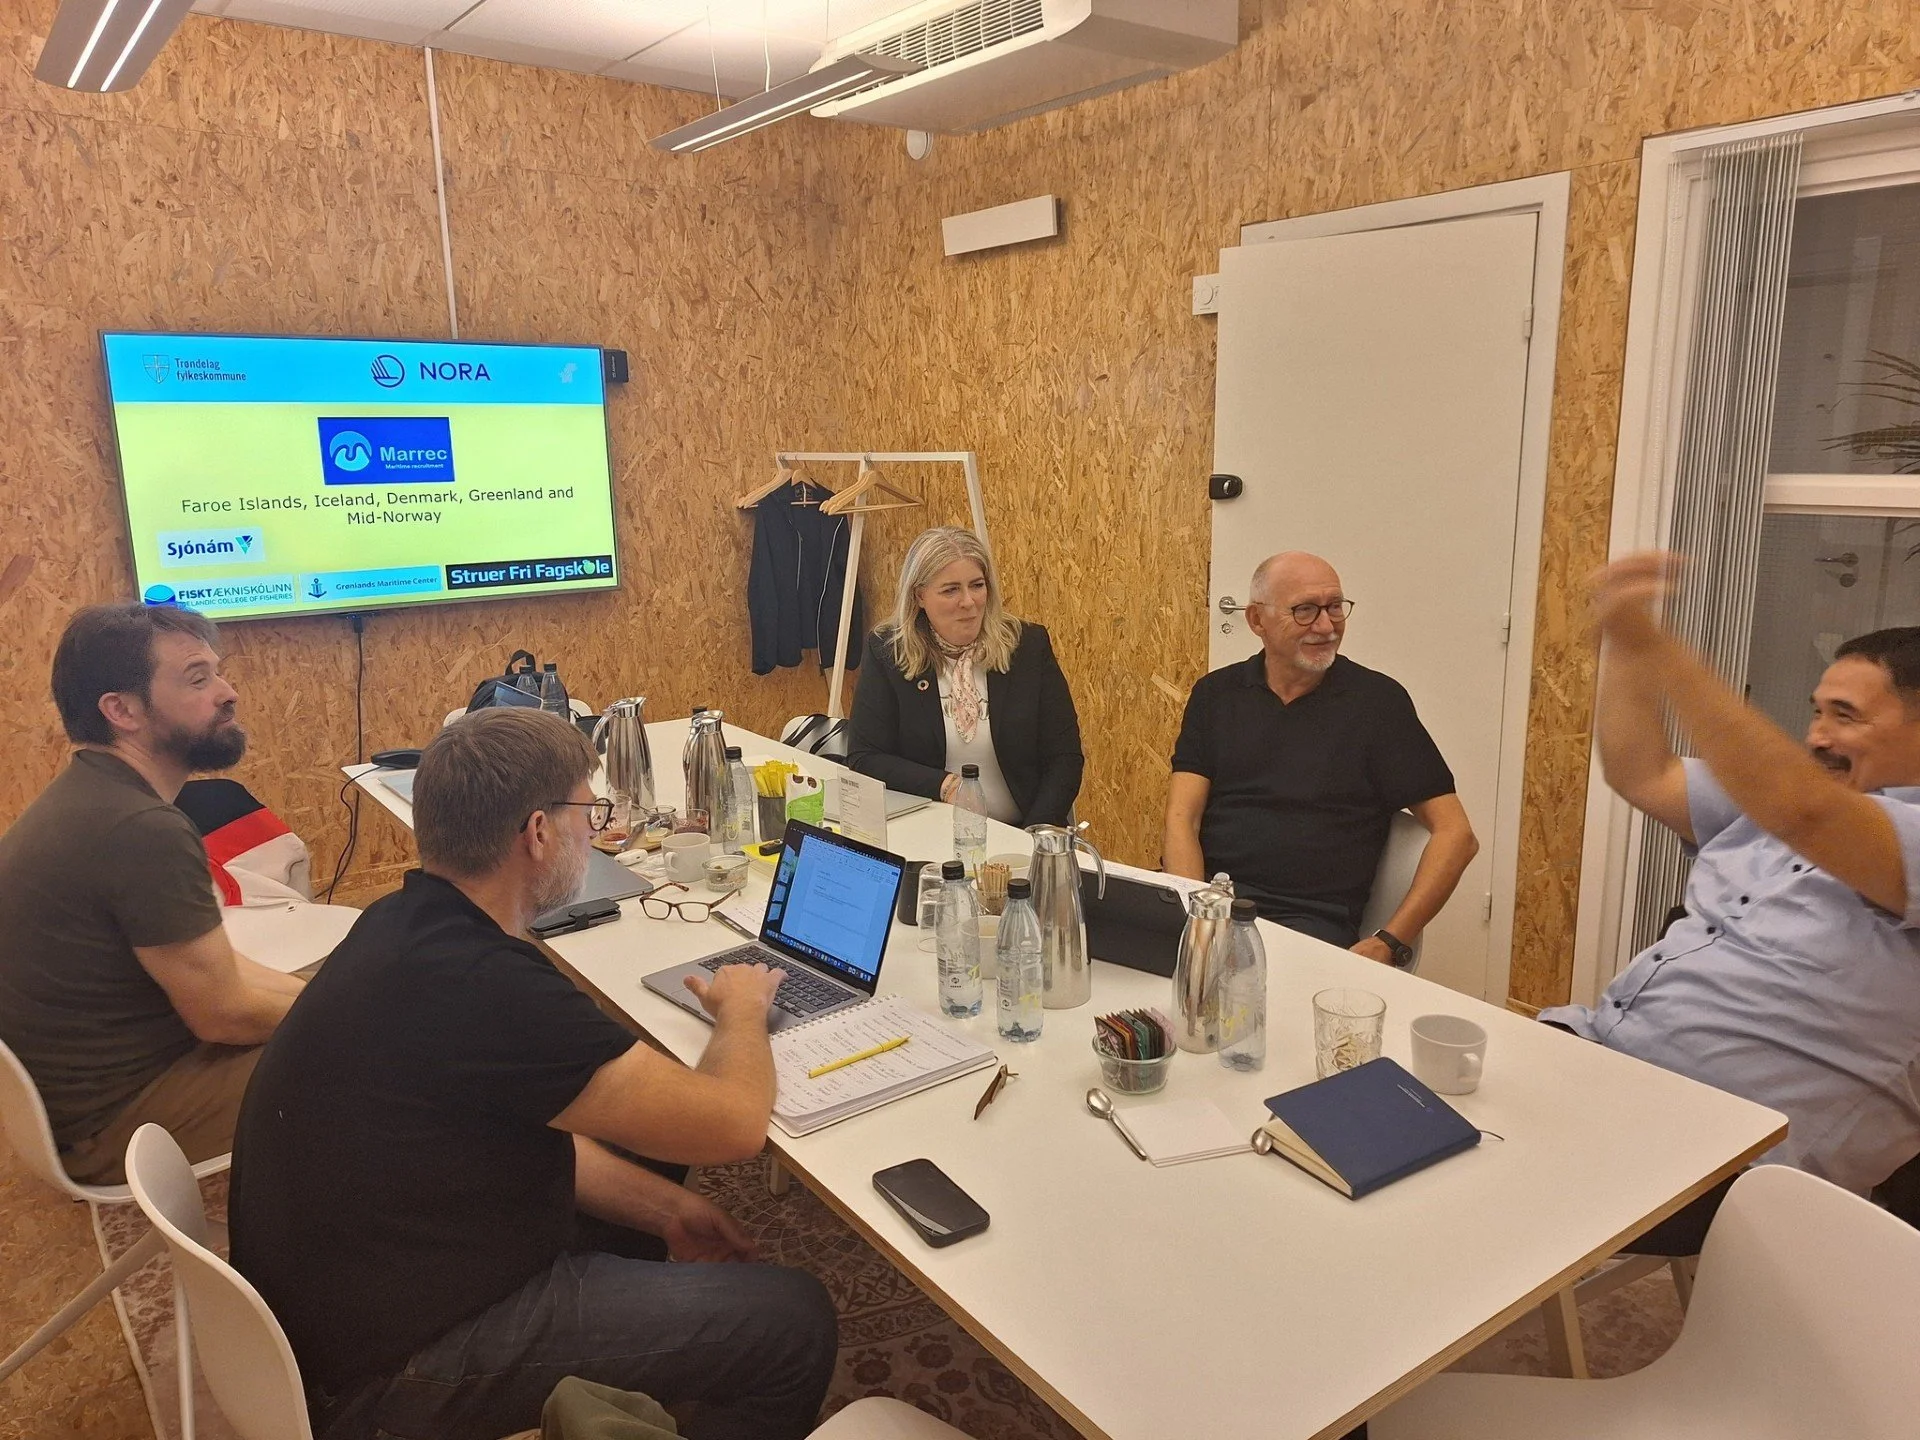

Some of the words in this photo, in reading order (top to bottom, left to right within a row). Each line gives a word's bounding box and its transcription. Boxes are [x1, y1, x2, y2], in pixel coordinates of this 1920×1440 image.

[175, 358, 221, 370] Trøndelag
[419, 361, 491, 381] NORA
[176, 370, 247, 382] fylkeskommune
[380, 446, 448, 462] Marrec
[411, 462, 444, 470] recruitment
[182, 499, 232, 513] Faroe
[239, 496, 308, 511] Islands,
[314, 492, 381, 508] Iceland,
[387, 490, 463, 505] Denmark,
[468, 487, 543, 502] Greenland
[548, 486, 574, 499] and
[347, 510, 442, 525] Mid-Norway
[167, 538, 234, 559] Sjónám
[451, 567, 505, 585] Struer
[509, 565, 531, 580] Fri
[335, 580, 376, 591] Grønlands
[377, 578, 412, 587] Maritime
[412, 576, 438, 586] Center
[178, 583, 292, 600] FISKTÆKNISKÓLINN
[217, 596, 248, 604] COLLEGE
[249, 594, 258, 602] OF
[259, 592, 293, 601] FISHERIES
